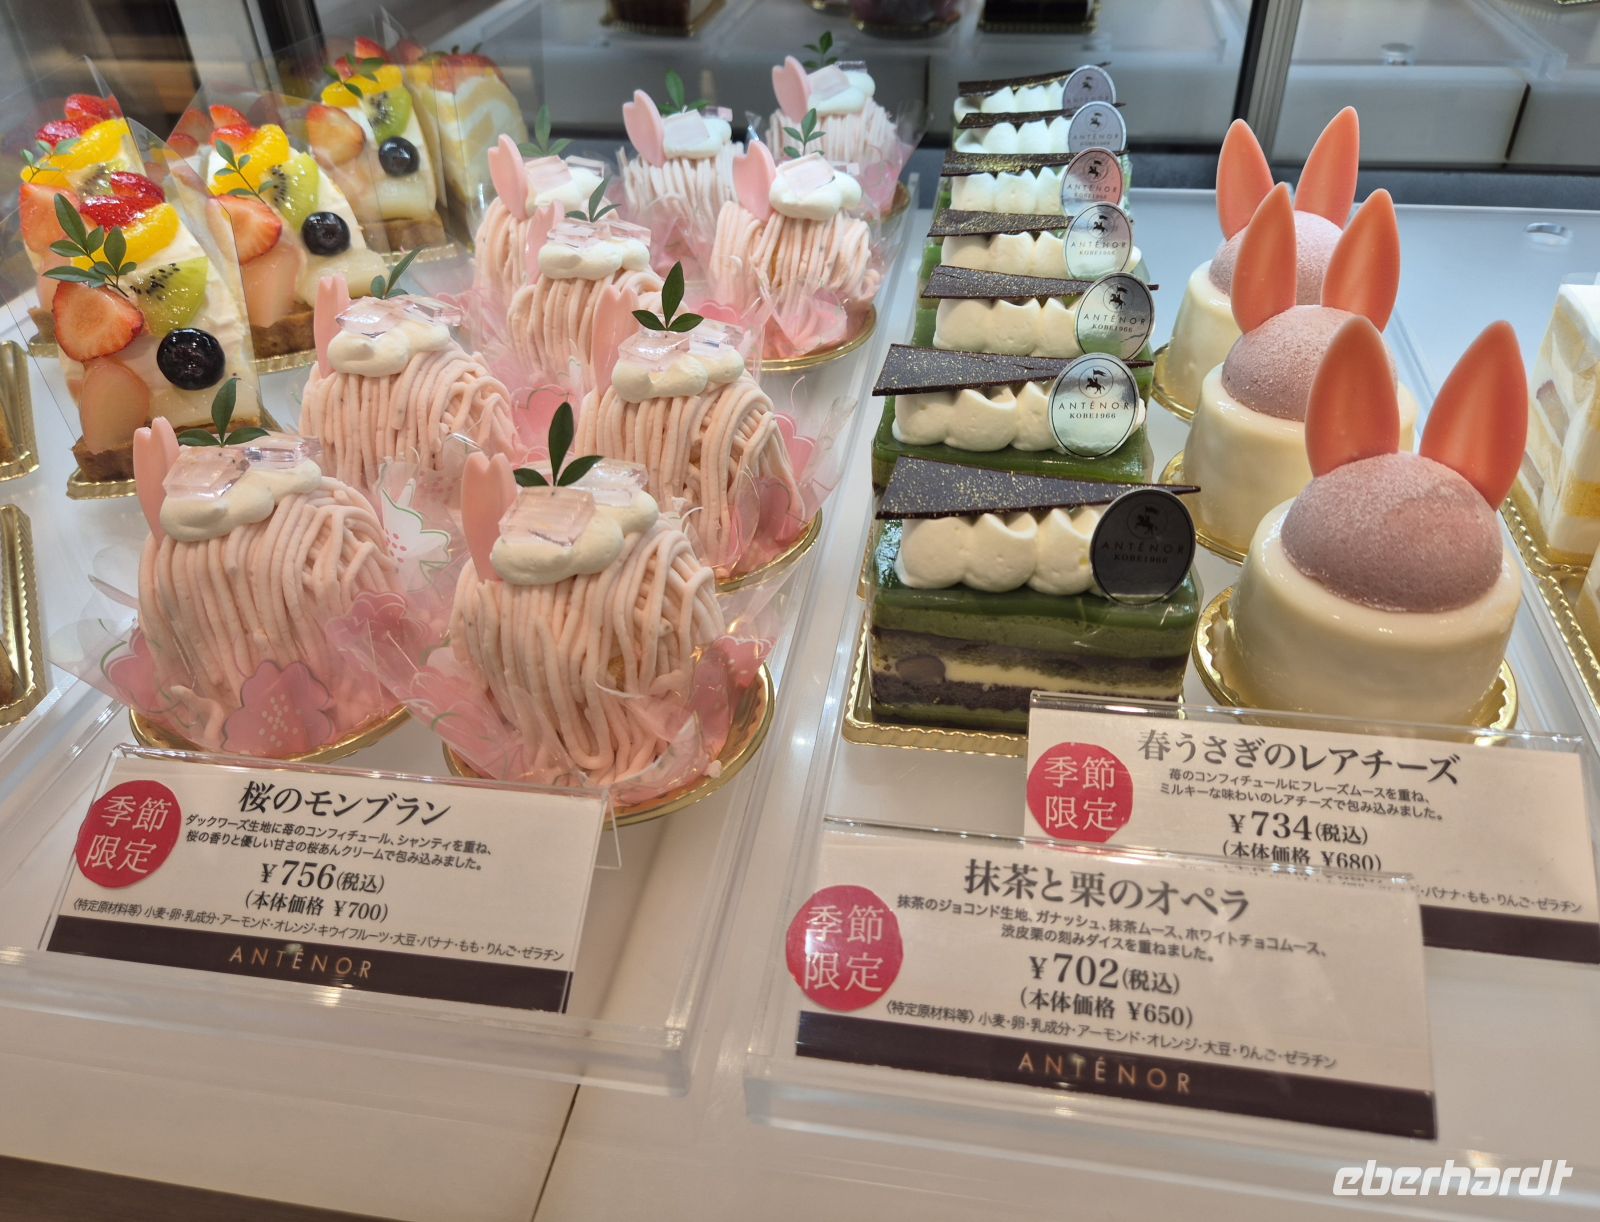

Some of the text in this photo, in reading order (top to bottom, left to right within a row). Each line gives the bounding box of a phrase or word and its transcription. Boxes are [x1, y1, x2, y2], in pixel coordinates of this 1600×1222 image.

[1044, 756, 1115, 791] 季節
[1138, 729, 1461, 785] 春うさぎのレアチーズ
[238, 780, 451, 826] 桜のモンブラン
[1160, 783, 1443, 821] ミルキーな味わいのレアチーズで包み込みました。
[1169, 767, 1429, 804] 苺のコンフィチュールにフレーズムースを重ね、
[101, 796, 172, 832] 季節
[1045, 795, 1117, 831] 限定
[84, 835, 157, 873] 限定
[185, 814, 492, 855] ダックワーズ生地に苺のコンフィチュール、シャンティを重ね、
[186, 830, 482, 871] 桜の香りと優しい甘さの桜あんクリームで包み込みました。
[964, 858, 1248, 922] 抹茶と栗のオペラ
[805, 904, 884, 944] 季節
[1001, 923, 1213, 962] 渋皮栗の刻みダイスを重ねました。
[804, 952, 883, 992] 限定
[1018, 1053, 1190, 1095] ANTÉNOR
